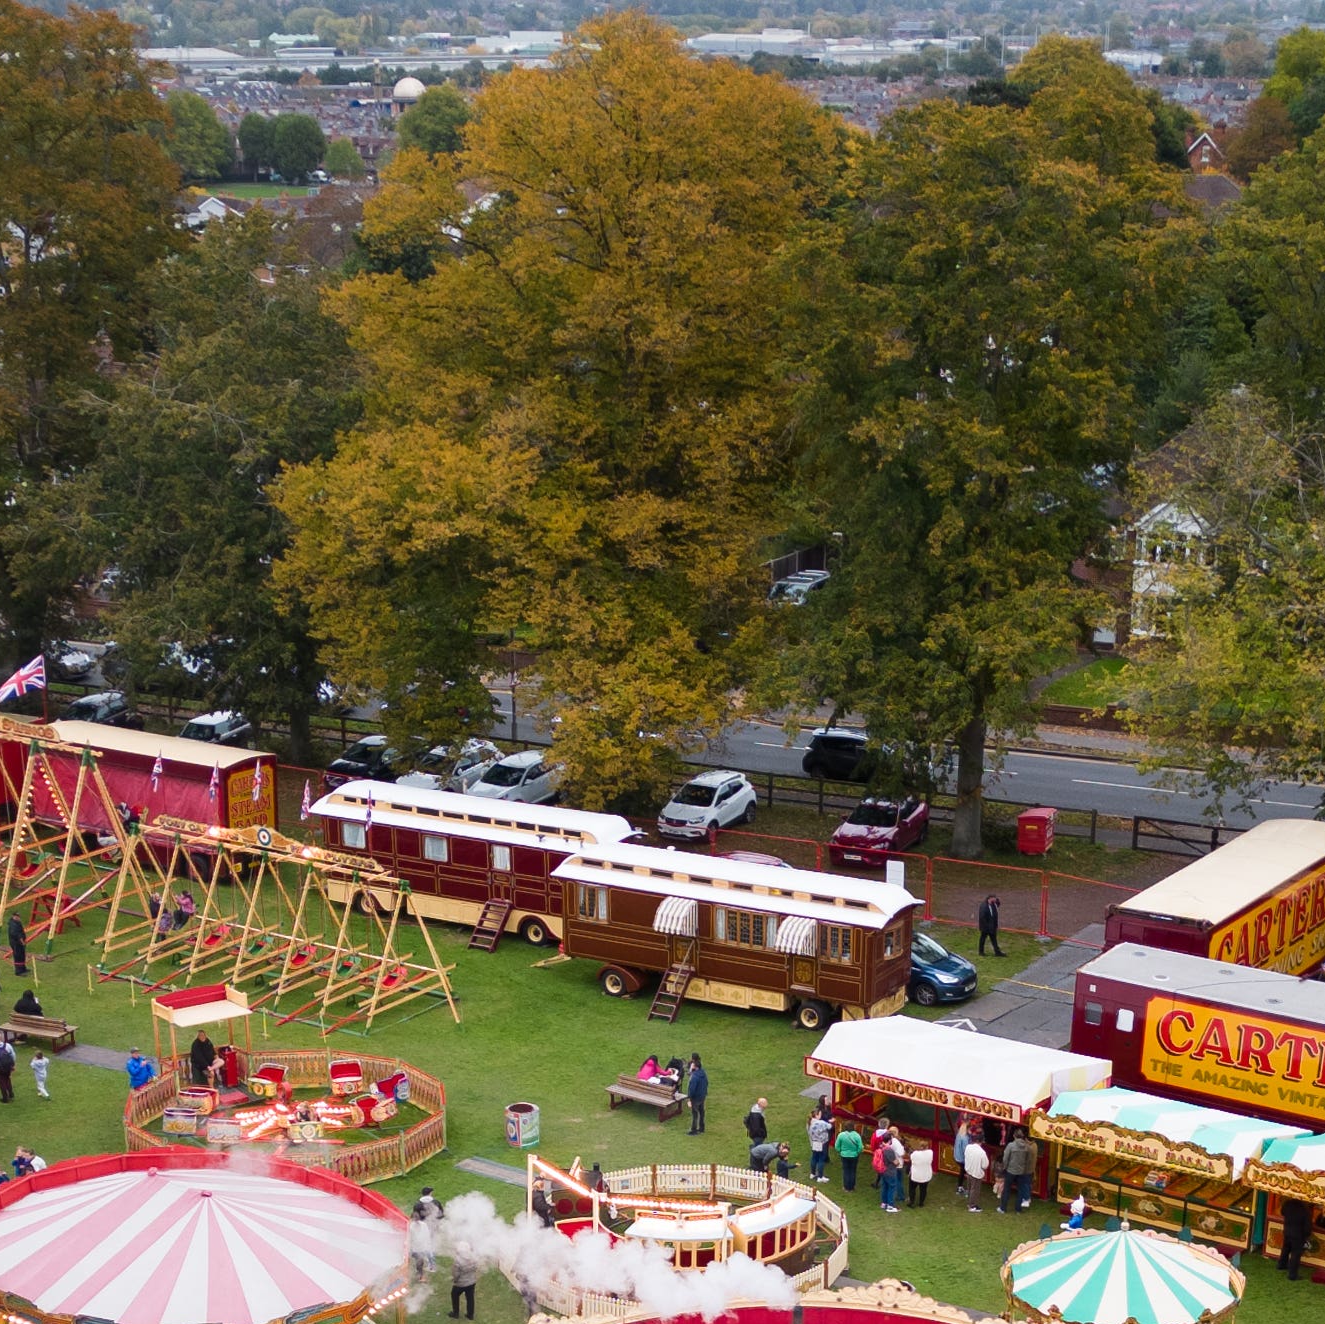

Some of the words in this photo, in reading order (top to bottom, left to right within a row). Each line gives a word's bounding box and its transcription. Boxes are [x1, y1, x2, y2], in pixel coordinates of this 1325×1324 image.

[812, 1061, 875, 1089] ORIGINAL
[877, 1076, 949, 1105] SHOOTING
[953, 1092, 1014, 1120] SALOON
[1150, 1057, 1184, 1079] THE
[1191, 1067, 1270, 1097] AMAZING
[1252, 1169, 1325, 1200] MODERN
